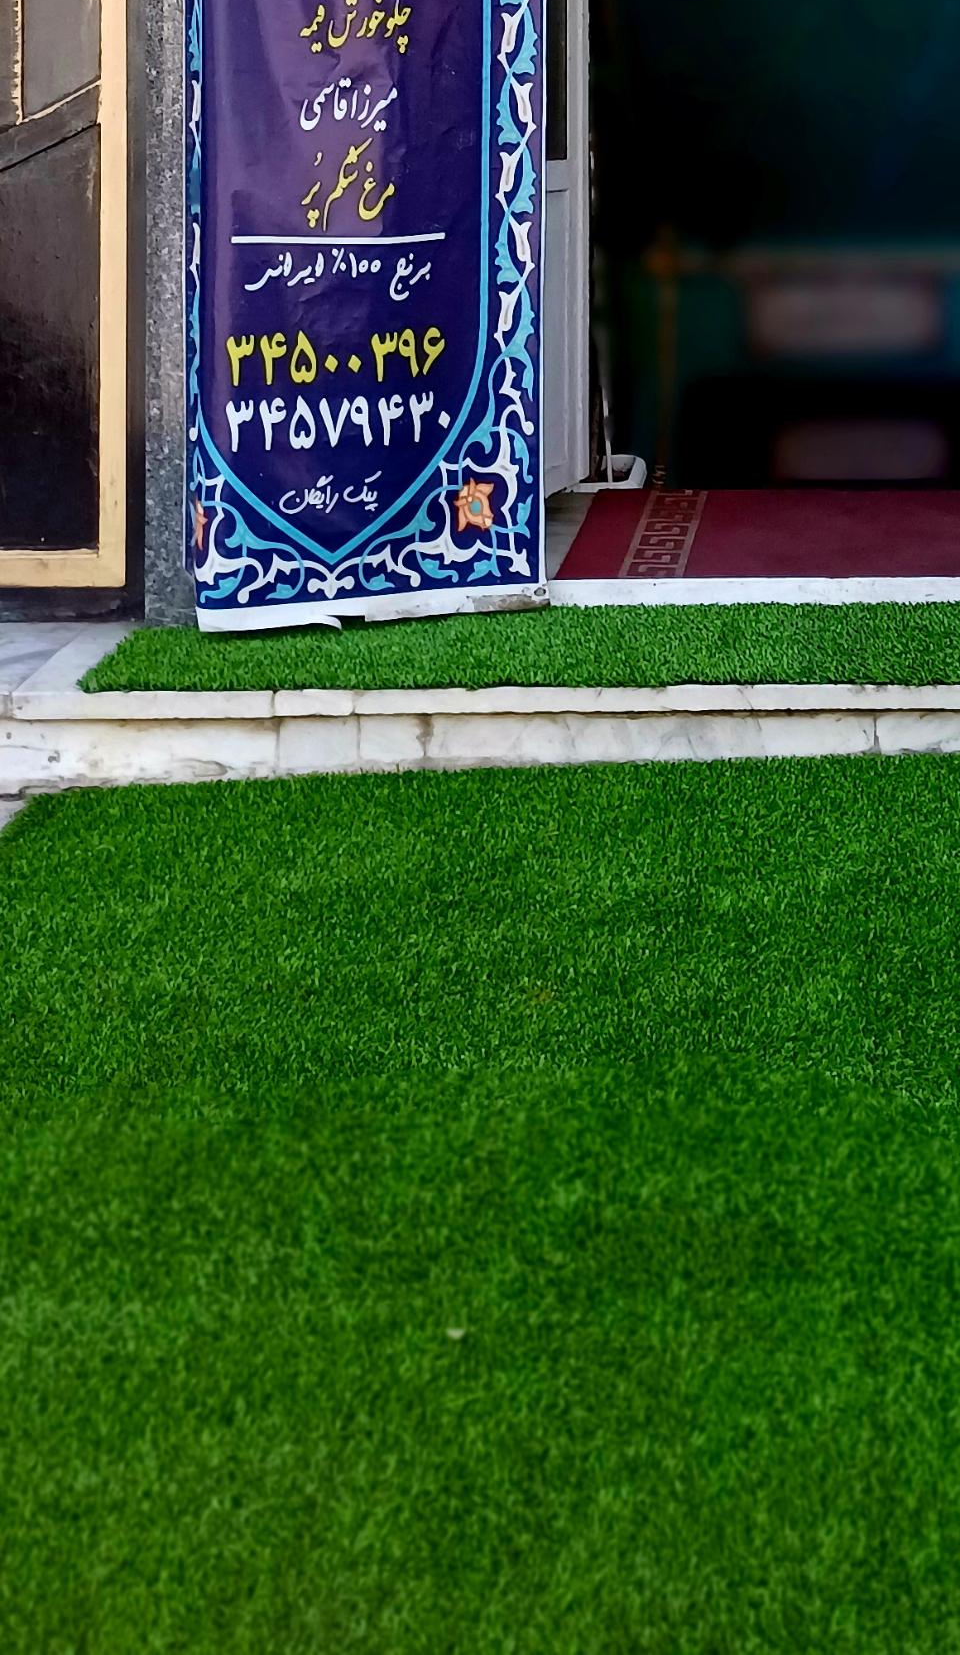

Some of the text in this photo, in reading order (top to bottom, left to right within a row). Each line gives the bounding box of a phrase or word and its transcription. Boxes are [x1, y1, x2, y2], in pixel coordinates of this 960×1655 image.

[322, 138, 373, 232] شکم
[357, 161, 396, 221] مرغ
[244, 250, 325, 292] ایرانی
[389, 252, 432, 302] برنج
[225, 325, 447, 387] ۳۴۵۰۰۳۹۶
[225, 390, 451, 453] ۳۴۵۷۹۴۳۰
[278, 471, 382, 515] پیک رایگان
